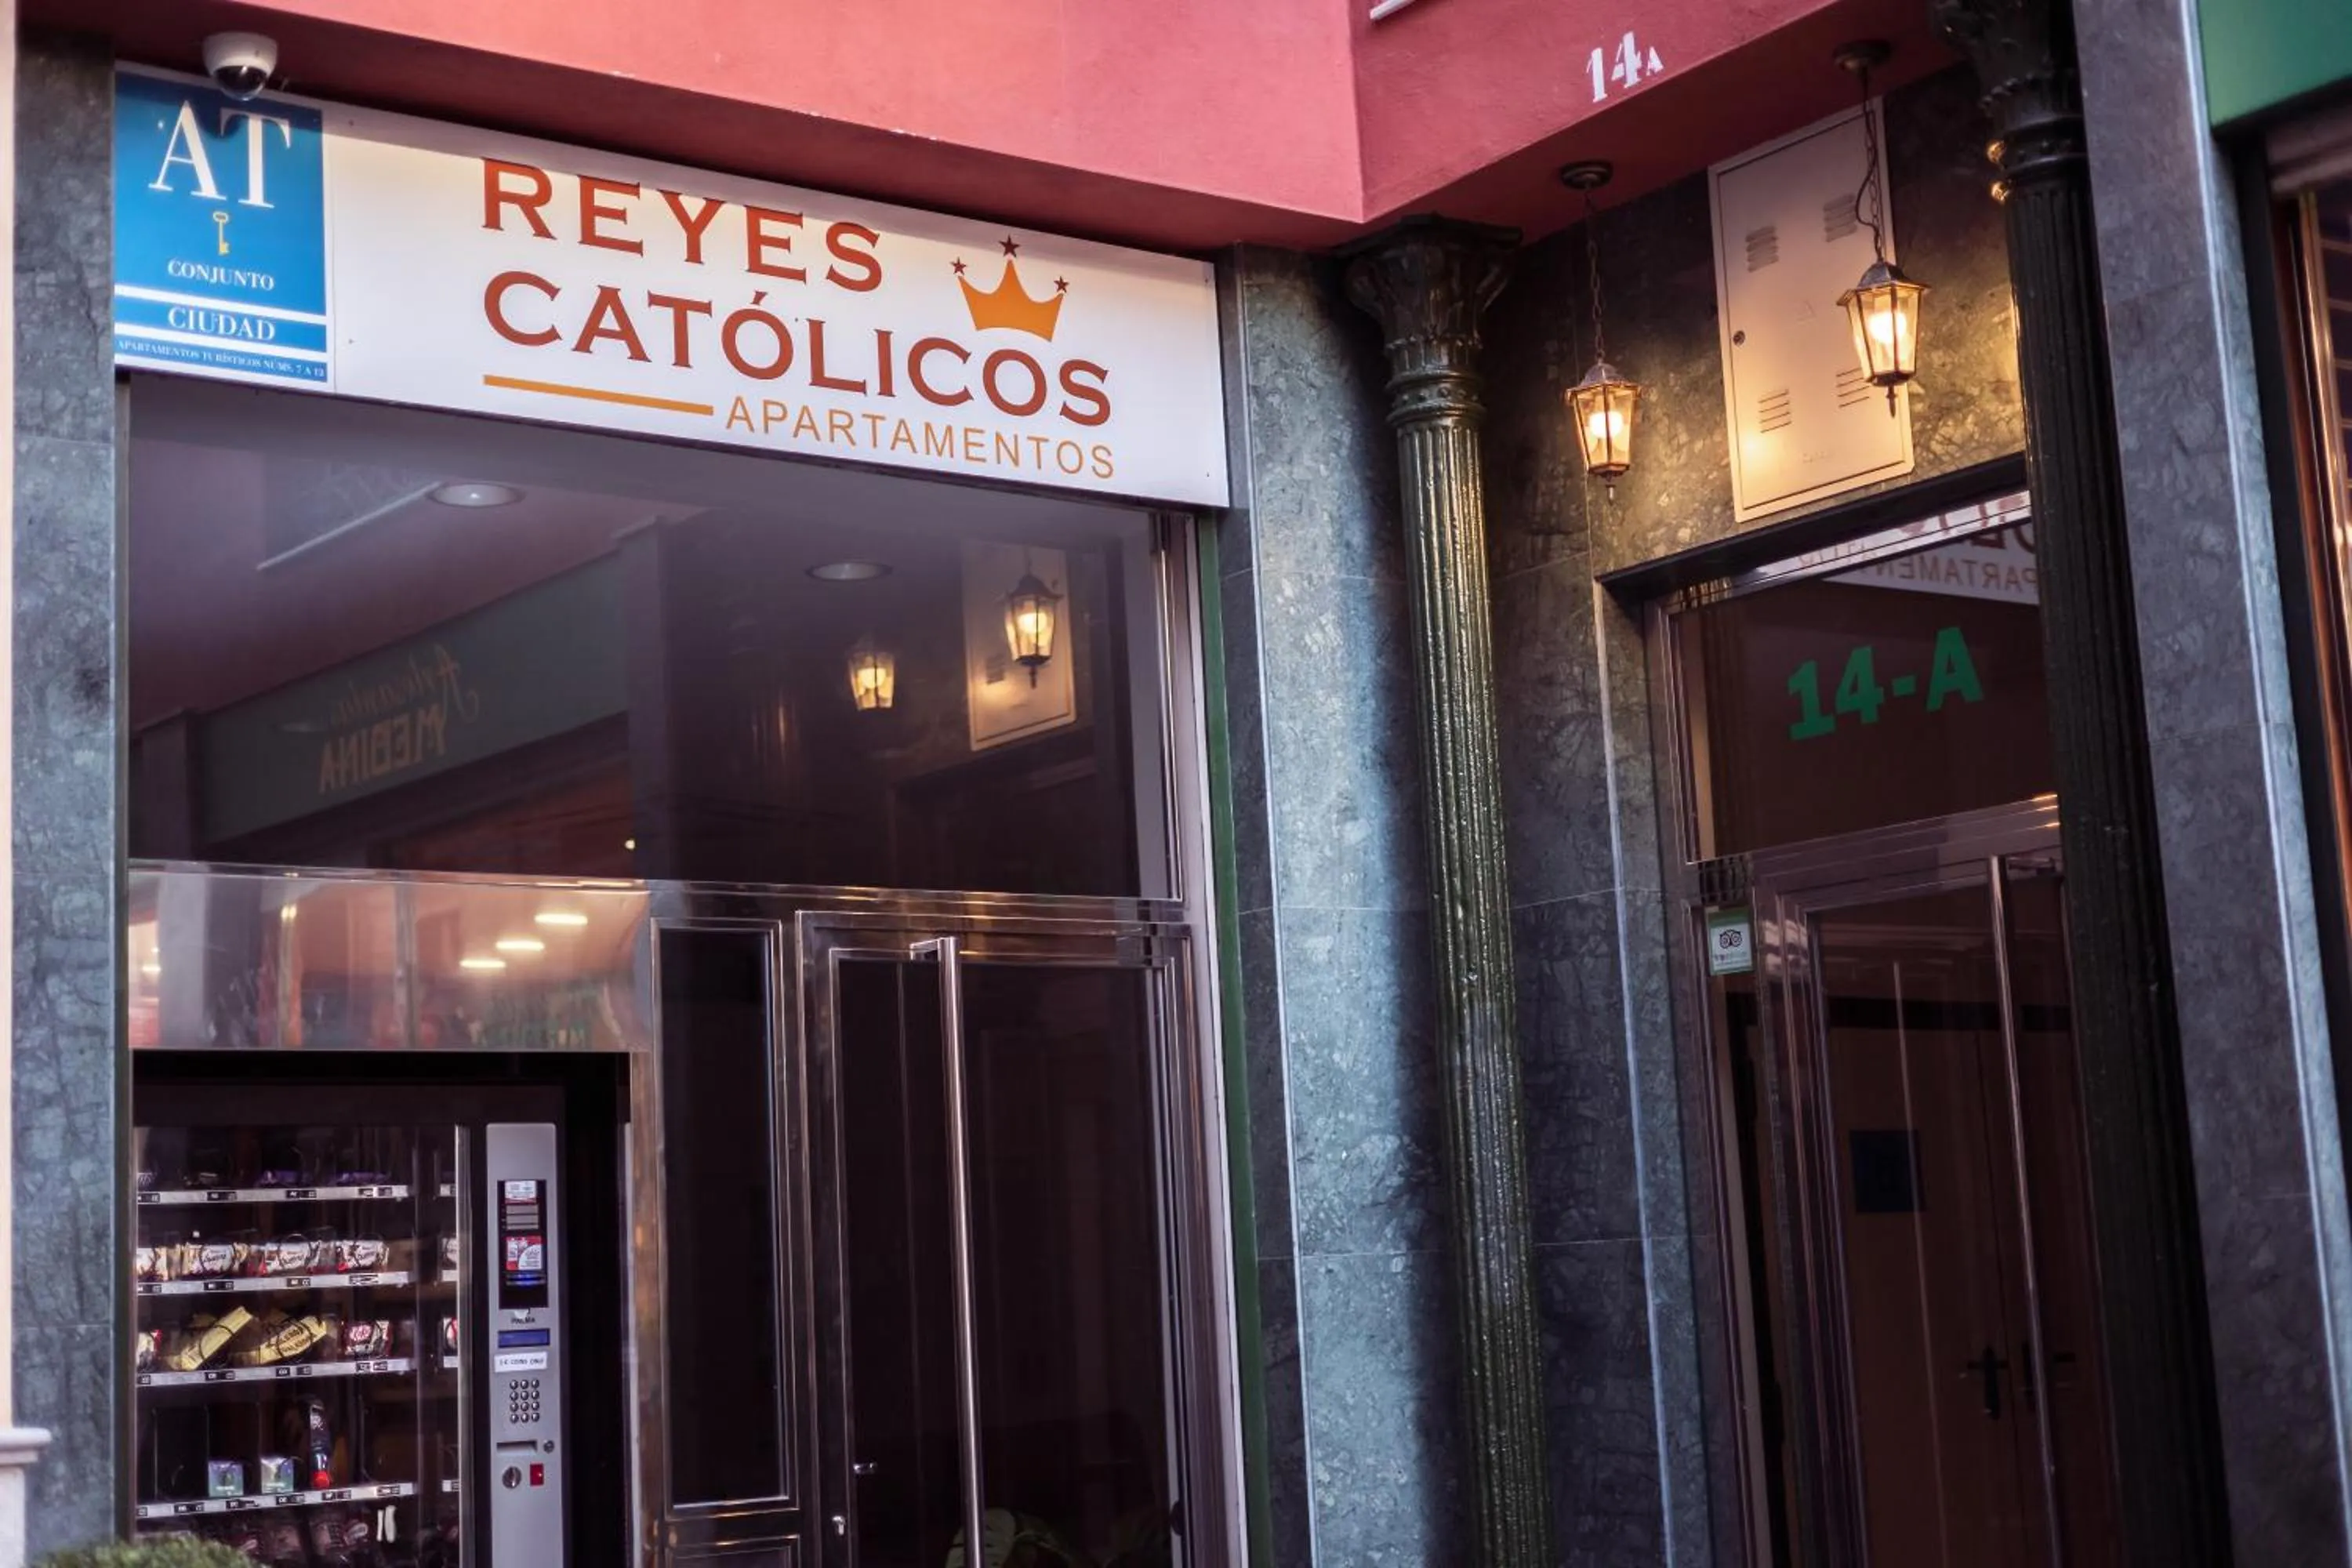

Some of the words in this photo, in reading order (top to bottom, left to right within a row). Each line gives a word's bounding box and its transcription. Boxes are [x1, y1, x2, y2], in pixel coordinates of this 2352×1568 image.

[148, 100, 292, 209] AT
[481, 158, 883, 292] REYES
[167, 257, 275, 292] CONJUNTO
[118, 339, 199, 358] APARTAMENTOS
[167, 306, 275, 341] CIUDAD
[484, 270, 1112, 426] CATÓLICOS
[724, 396, 1115, 480] APARTAMENTOS
[1788, 626, 1984, 741] 14-A
